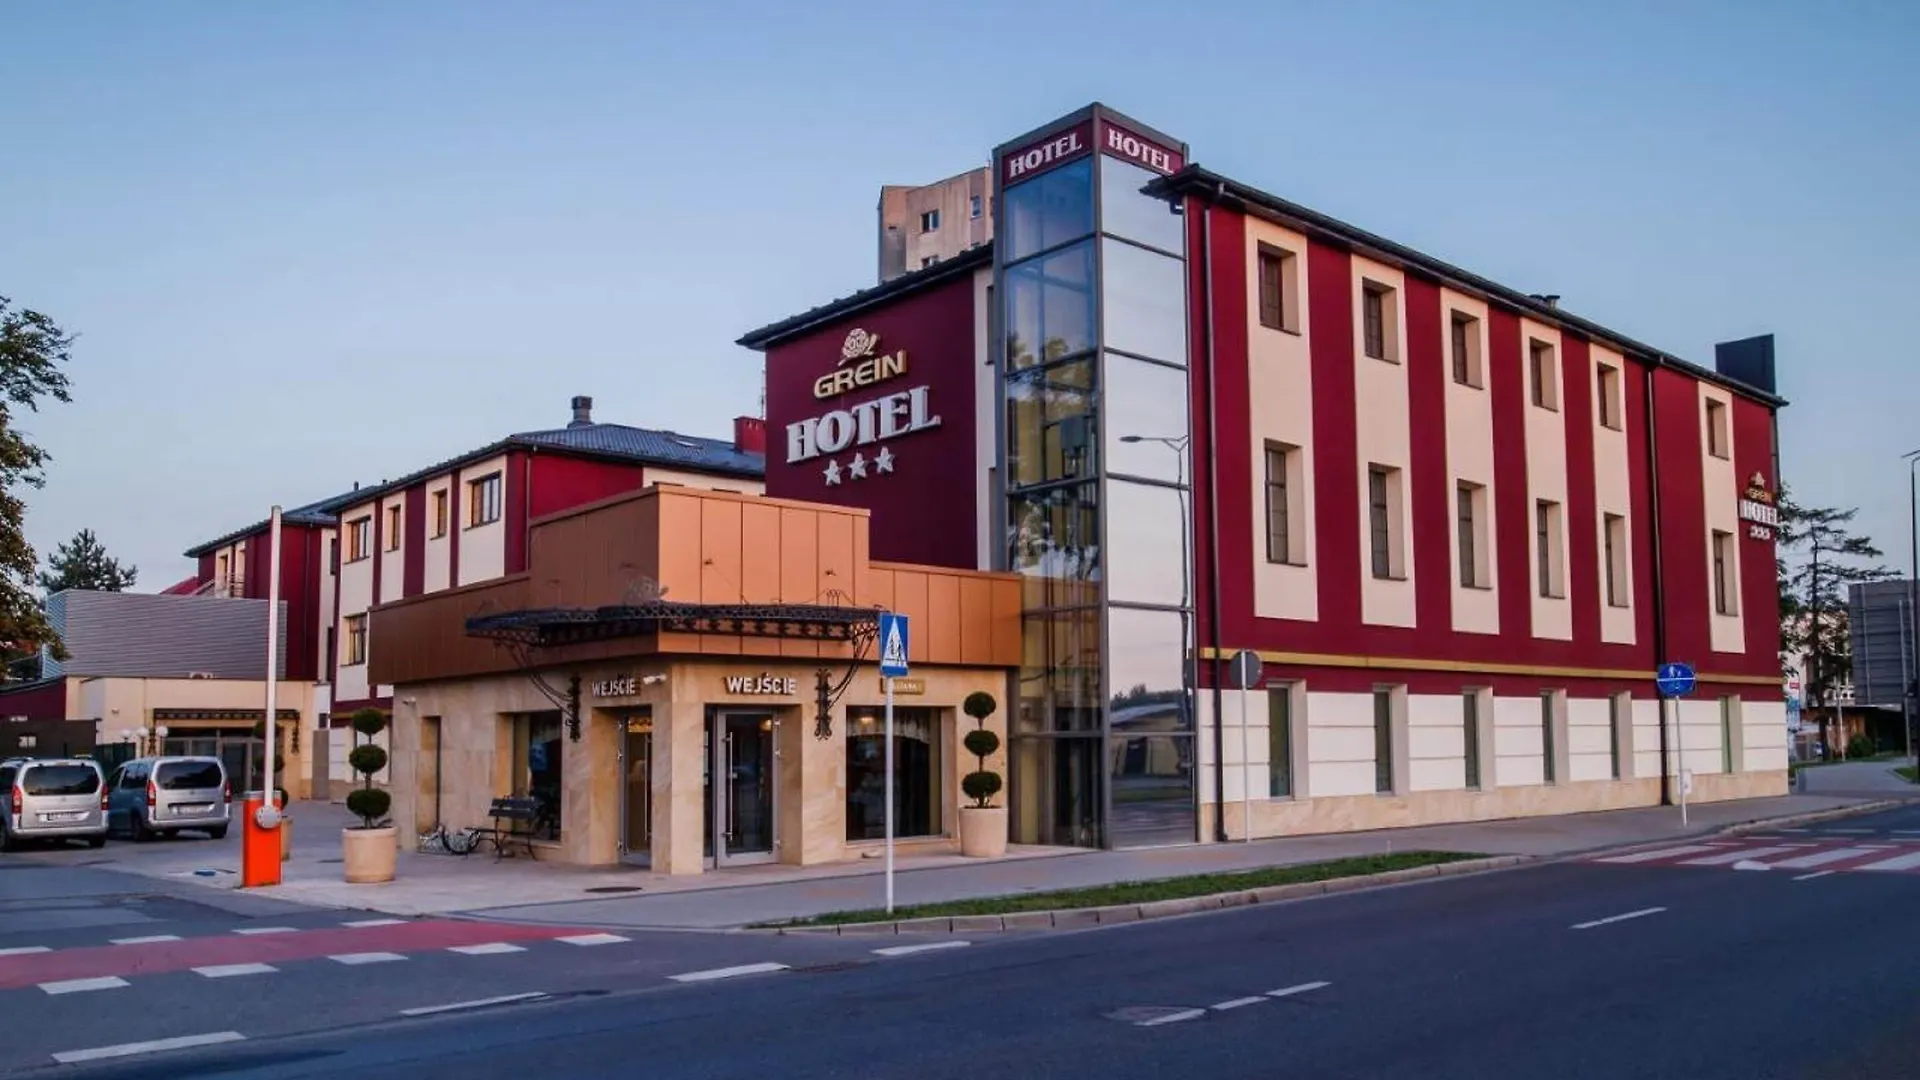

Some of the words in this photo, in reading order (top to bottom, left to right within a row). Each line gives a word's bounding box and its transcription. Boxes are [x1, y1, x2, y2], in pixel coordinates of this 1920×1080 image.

[1009, 131, 1082, 178] HOTEL
[1109, 129, 1174, 174] HOTEL
[814, 350, 906, 399] GREIN
[786, 385, 942, 463] HOTEL
[1740, 499, 1778, 526] HOTEL
[725, 672, 797, 694] WEJŚCIE
